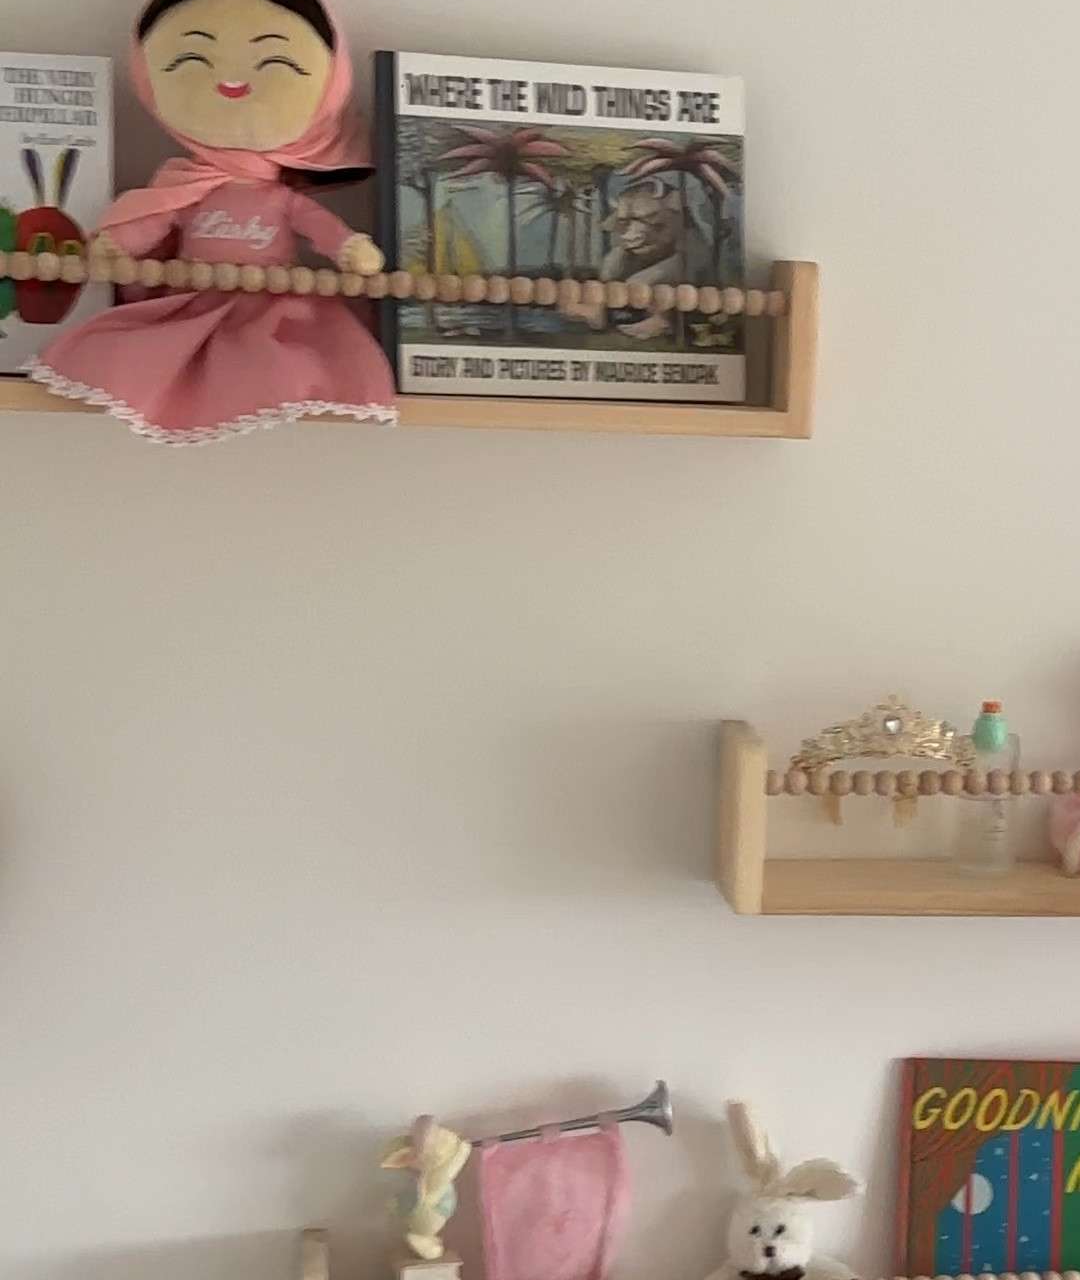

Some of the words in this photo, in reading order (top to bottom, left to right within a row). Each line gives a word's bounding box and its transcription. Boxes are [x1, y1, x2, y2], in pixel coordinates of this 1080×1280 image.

[404, 72, 482, 110] WHERE
[486, 78, 528, 112] THE
[533, 82, 588, 116] WILD
[592, 85, 671, 121] THINGS
[677, 91, 720, 124] ARE
[411, 355, 457, 378] STORY
[460, 357, 494, 379] AND
[498, 358, 567, 380] PICTURES
[570, 360, 590, 382] BY
